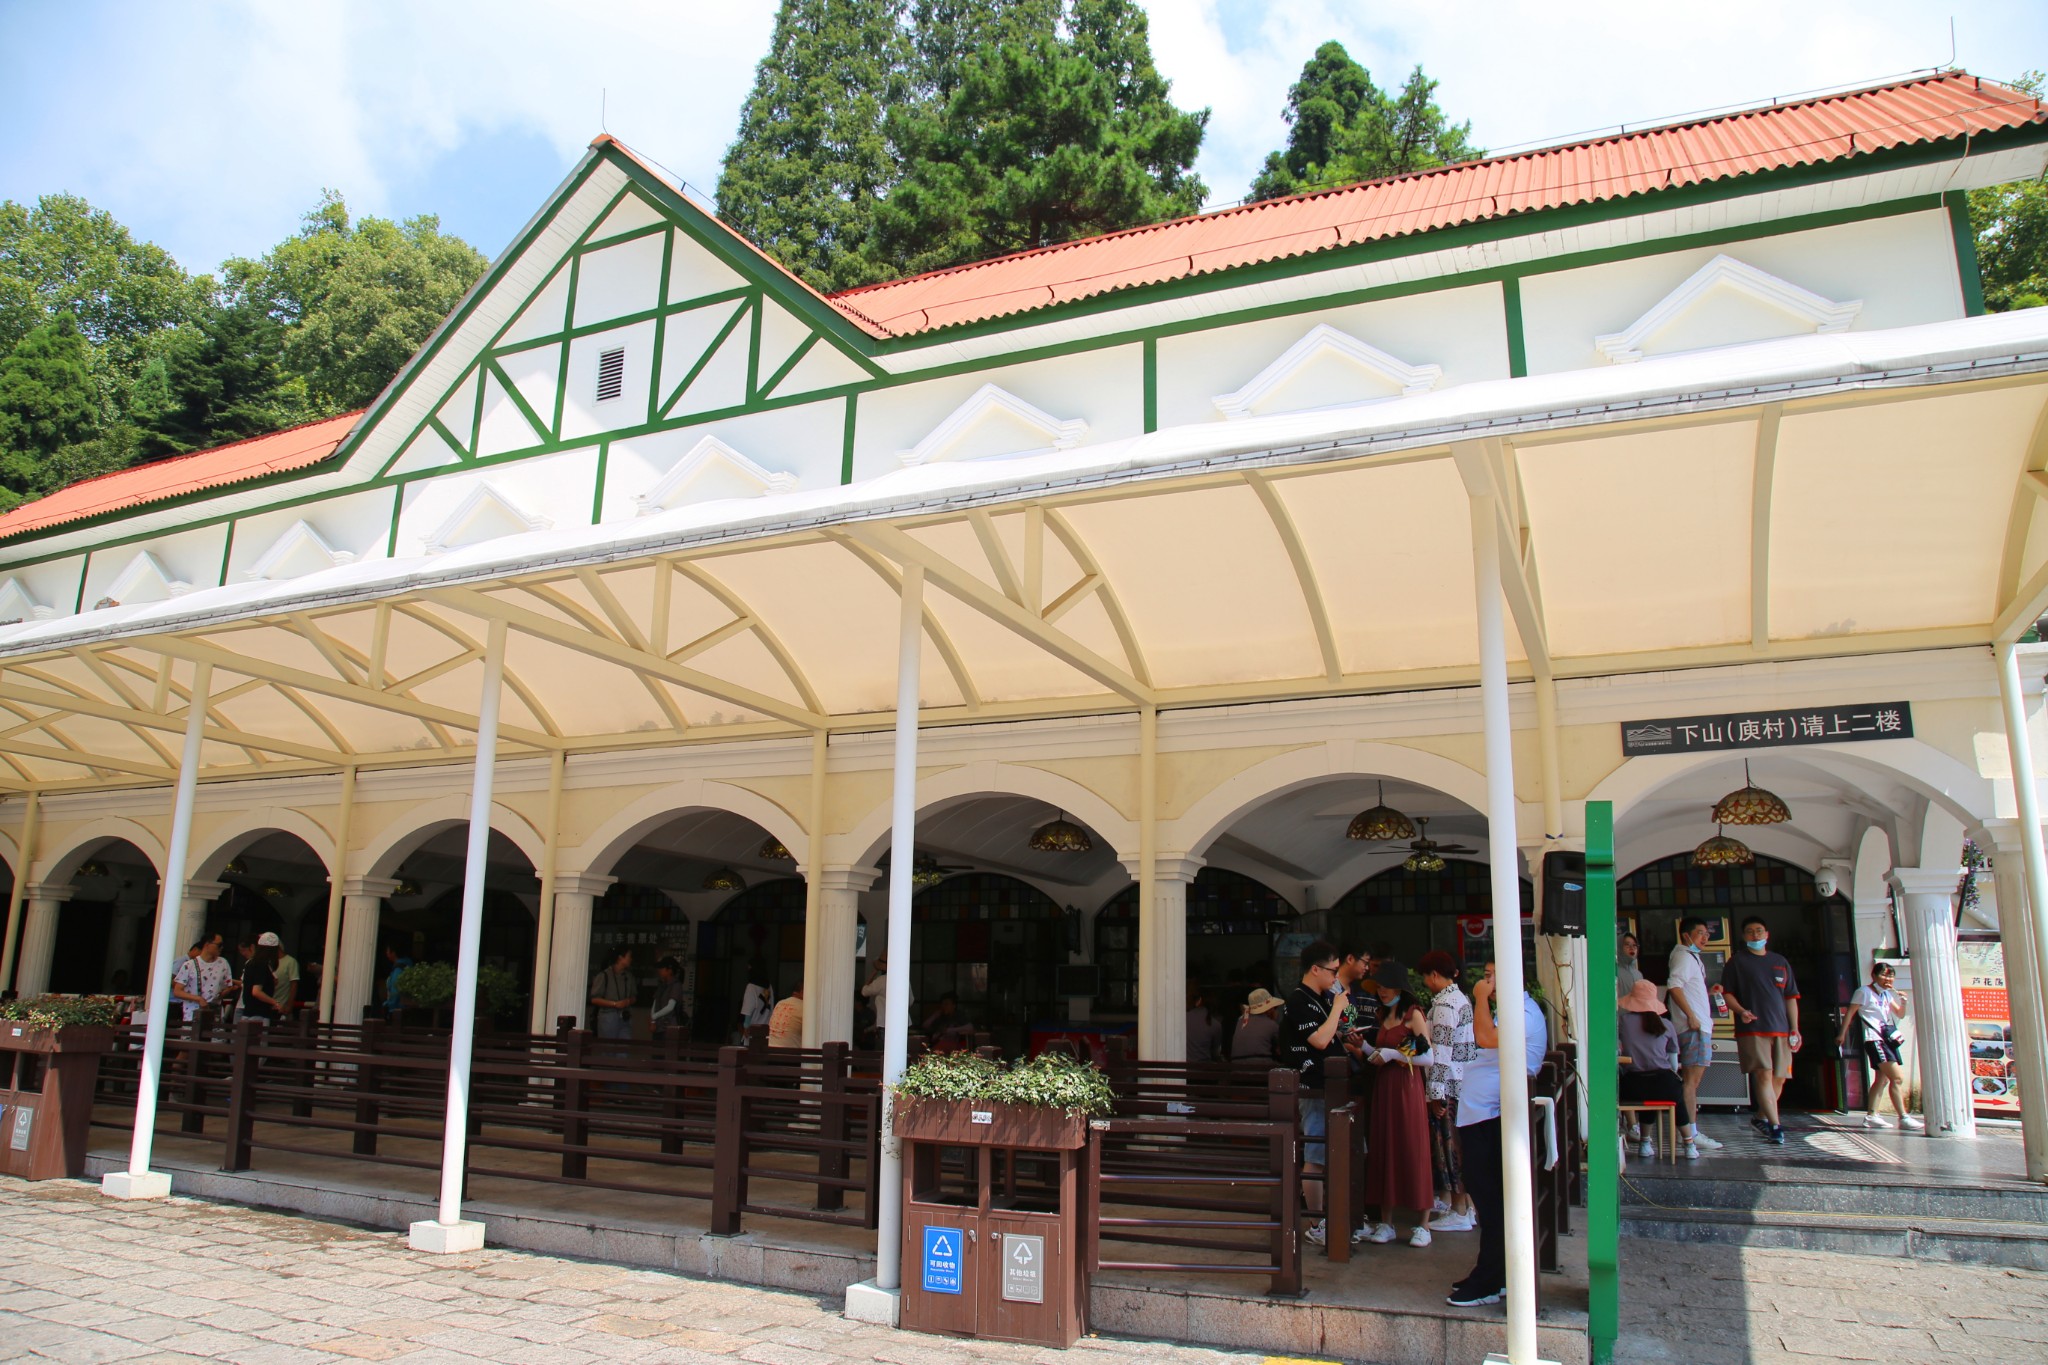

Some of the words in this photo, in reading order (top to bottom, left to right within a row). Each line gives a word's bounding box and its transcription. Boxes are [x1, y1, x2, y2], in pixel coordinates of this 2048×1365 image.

[1676, 709, 1902, 745] 下山(庾村)请上二楼
[929, 1259, 956, 1270] 可回收物
[1009, 1268, 1037, 1278] 其他垃圾
